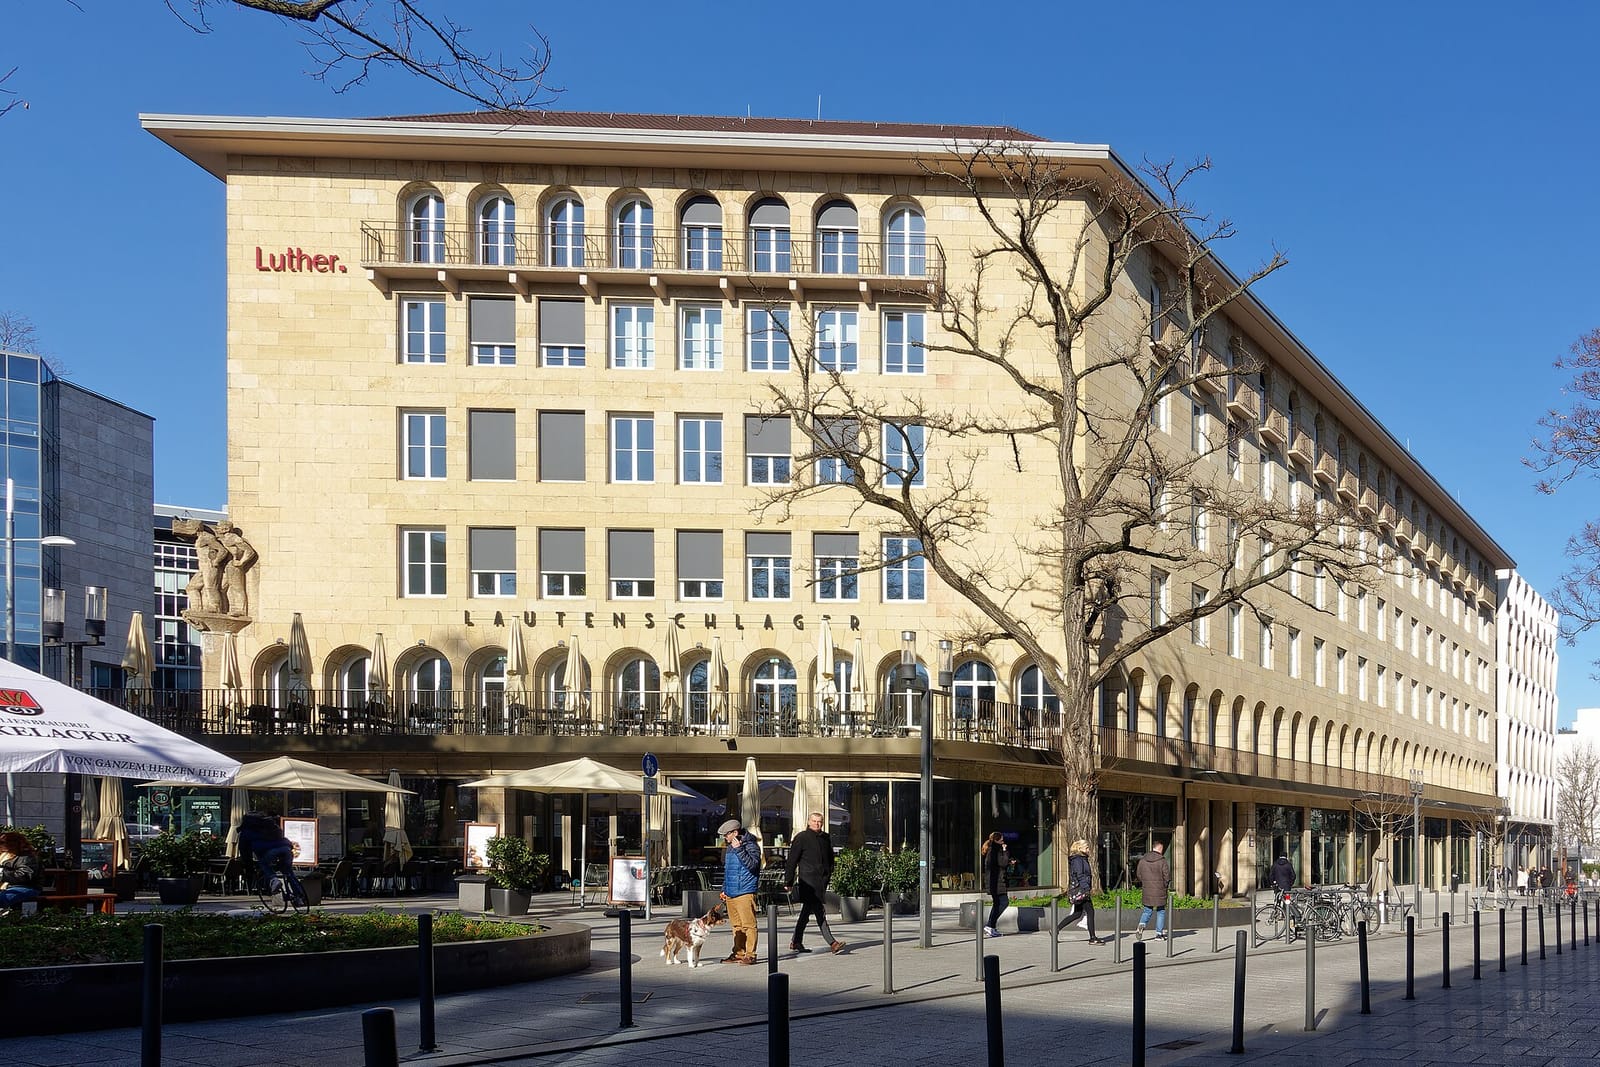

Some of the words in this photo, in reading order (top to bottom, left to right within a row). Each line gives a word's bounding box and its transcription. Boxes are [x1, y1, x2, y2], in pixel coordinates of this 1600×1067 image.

[255, 246, 347, 273] Luther.
[464, 610, 860, 632] LAUTENSCHLAGR
[66, 755, 92, 766] VON
[95, 758, 146, 771] GANZEM
[149, 764, 196, 775] HERZEN
[198, 769, 227, 779] HIER
